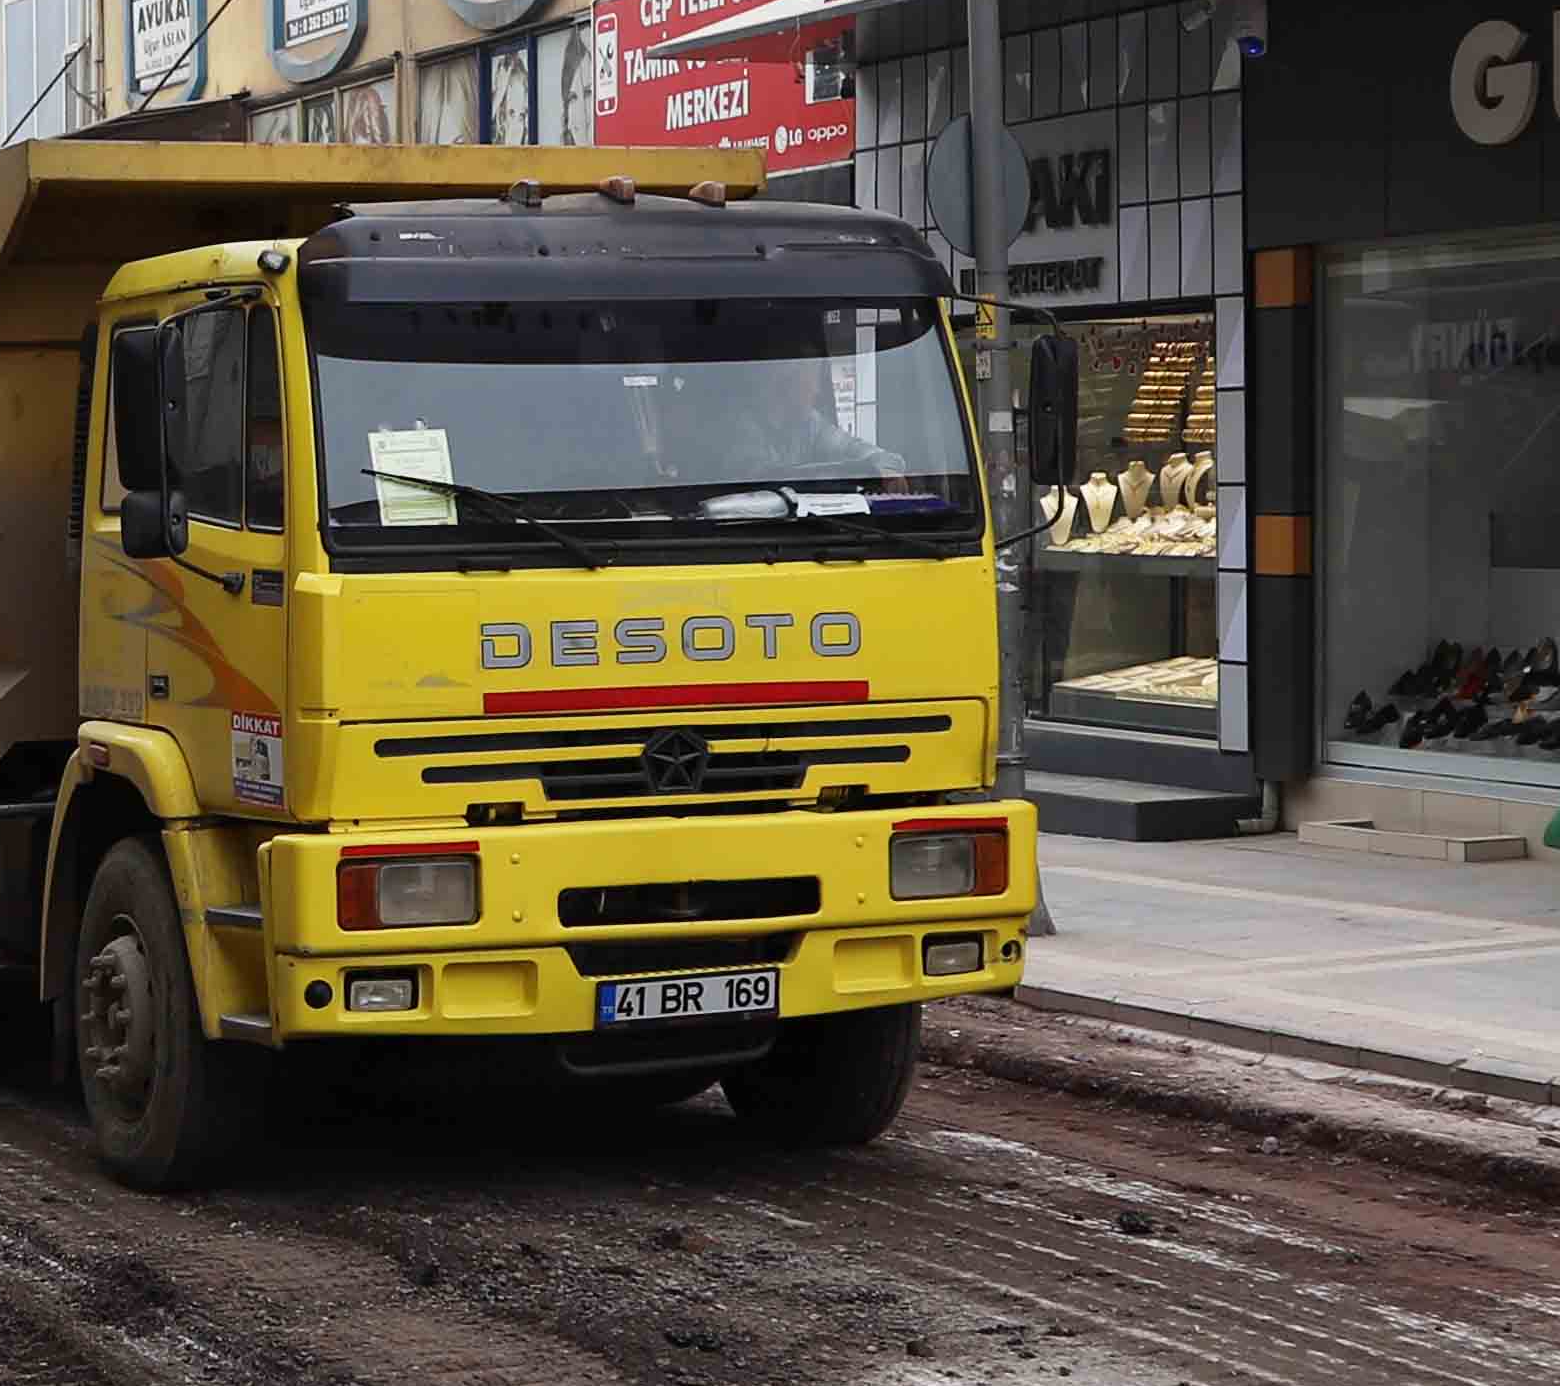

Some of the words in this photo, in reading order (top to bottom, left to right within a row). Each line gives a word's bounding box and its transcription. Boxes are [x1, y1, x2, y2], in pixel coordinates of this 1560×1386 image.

[666, 68, 749, 131] MERKEZİ
[481, 612, 861, 669] DESOTO
[232, 712, 280, 736] DİKKAT
[616, 986, 646, 1018] 41
[660, 980, 703, 1013] BR
[723, 975, 770, 1008] 169
